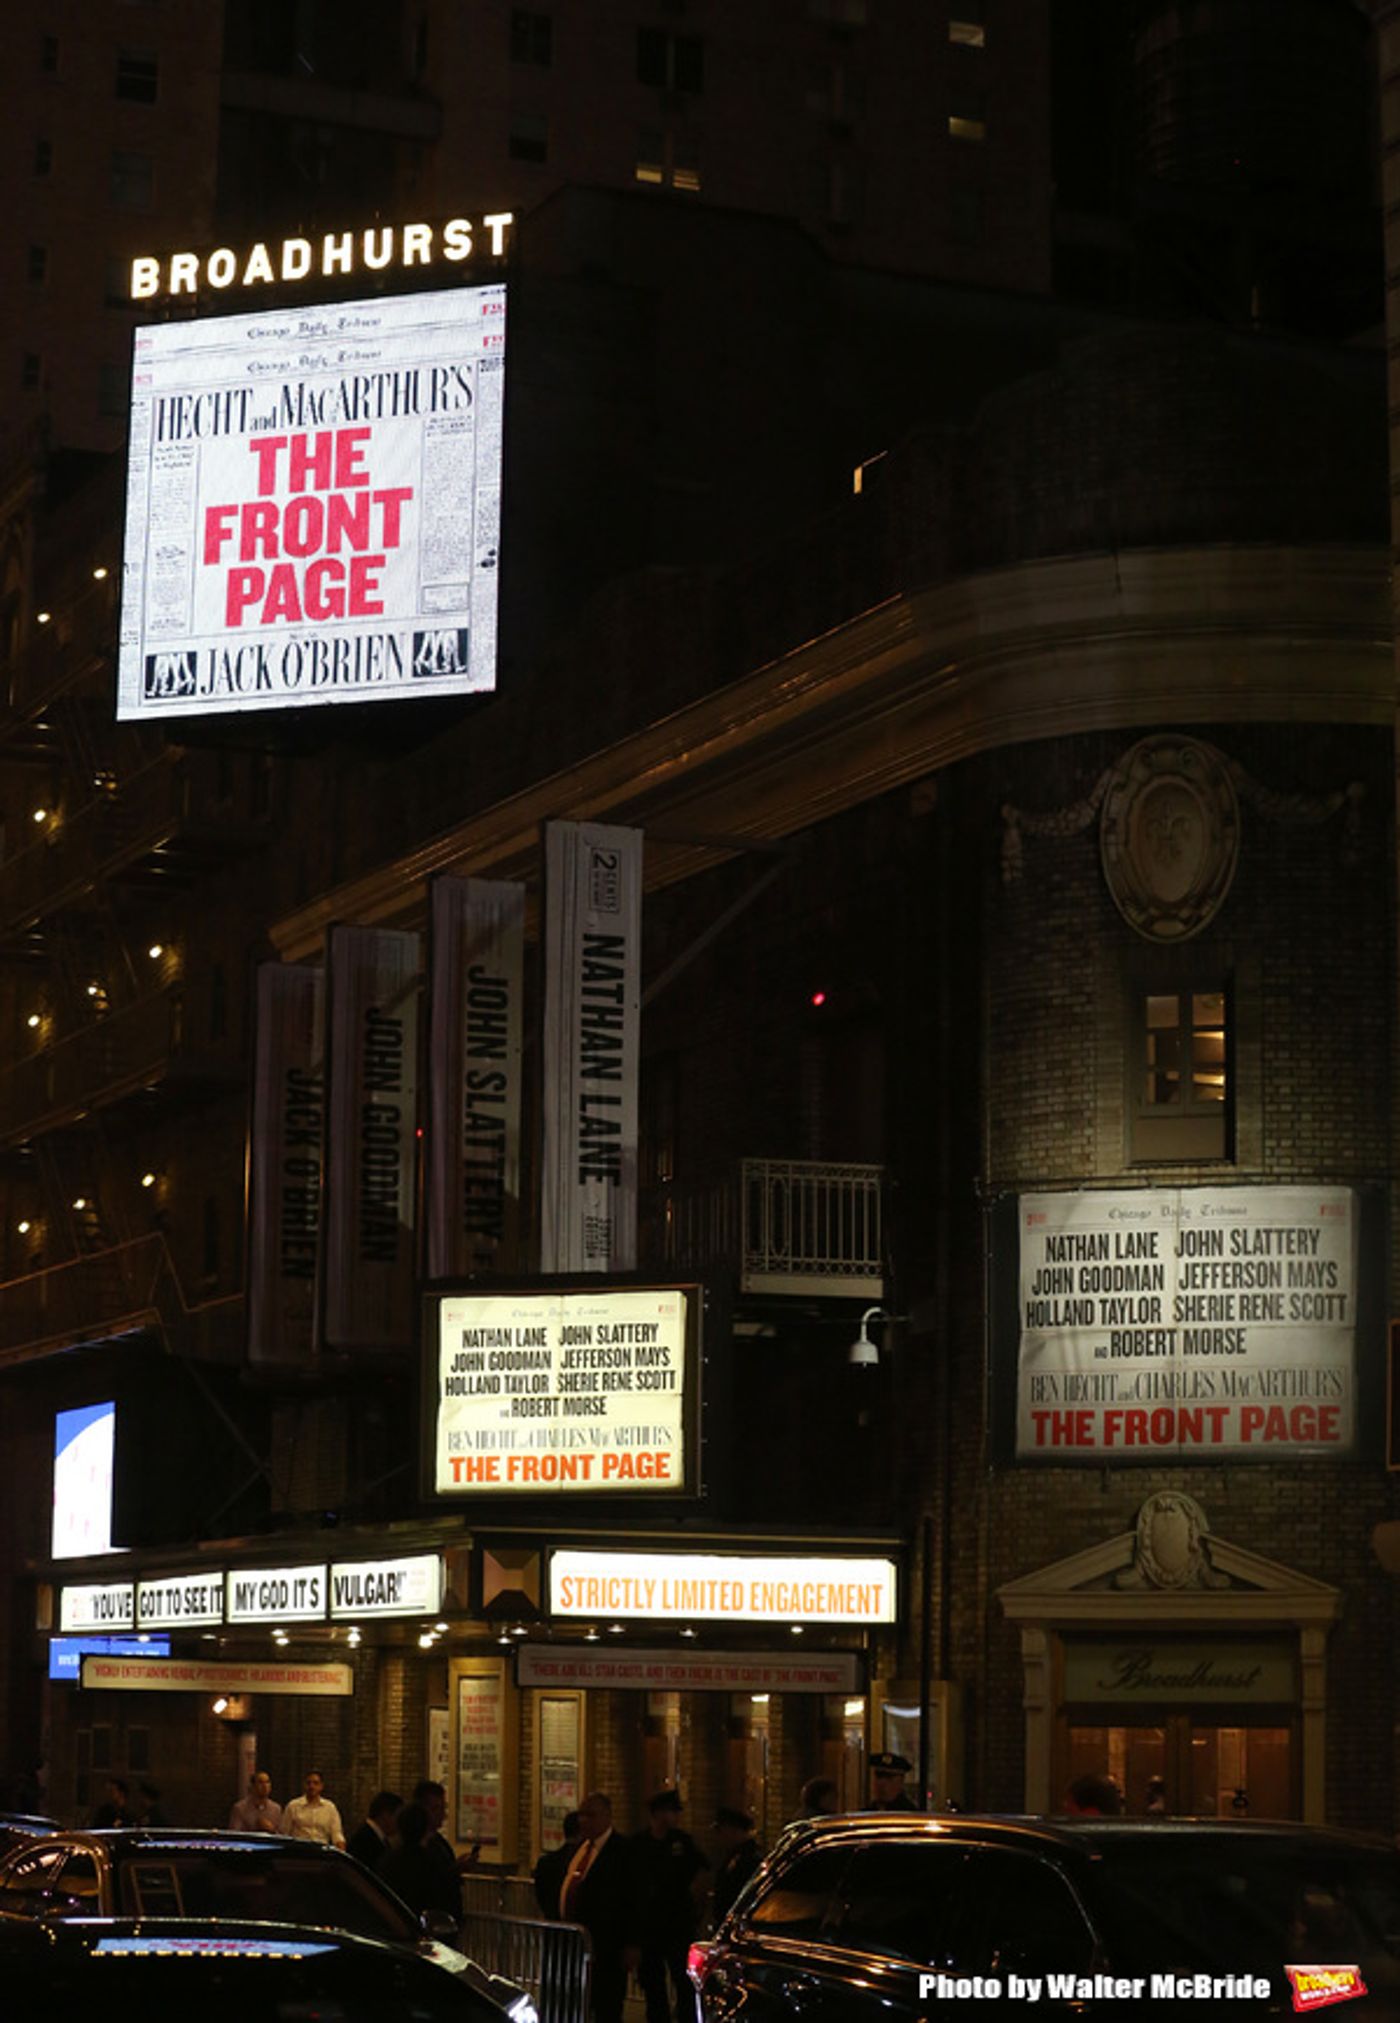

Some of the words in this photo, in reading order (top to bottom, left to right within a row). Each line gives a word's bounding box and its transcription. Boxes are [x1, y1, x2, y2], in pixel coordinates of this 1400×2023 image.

[131, 213, 513, 299] BROADHURST
[158, 388, 253, 442] HECHT
[249, 403, 278, 431] and
[249, 427, 372, 496] THE
[203, 487, 414, 566] FRONT
[225, 554, 386, 627] PAGE
[200, 643, 275, 697] JACK
[281, 633, 405, 689] O'BRIEN
[467, 964, 509, 1060] JOHN
[580, 933, 625, 1082] NATHAN
[364, 1006, 403, 1093] JOHN
[286, 1067, 324, 1148] JACK
[465, 1070, 507, 1241] SLATTERY
[578, 1093, 622, 1188] LANE
[360, 1103, 401, 1263] GOODMAN
[1046, 1233, 1109, 1262] NATHAN
[1115, 1231, 1159, 1260] LANE
[1174, 1229, 1223, 1258] JOHN
[1230, 1228, 1321, 1257] SLATTERY
[1032, 1267, 1074, 1296] JOHN
[1079, 1264, 1164, 1293] GOODMAN
[1179, 1261, 1282, 1290] JEFFERSON
[1288, 1260, 1338, 1288] MAYS
[1026, 1299, 1094, 1328] HOLLAND
[1101, 1296, 1162, 1325] TAYLOR
[1173, 1294, 1235, 1323] SHERIE
[1239, 1293, 1285, 1321] RENE
[1289, 1292, 1347, 1321] SCOTT
[462, 1328, 512, 1348] NATHAN
[516, 1327, 547, 1347] LANE
[558, 1325, 592, 1346] JOHN
[596, 1323, 659, 1345] SLATTERY
[1110, 1329, 1177, 1358] ROBERT
[1183, 1327, 1247, 1355] MORSE
[451, 1352, 484, 1373] JOHN
[488, 1350, 552, 1371] GOODMAN
[560, 1348, 631, 1369] JEFFERSON
[635, 1347, 671, 1367] MAYS
[445, 1376, 500, 1396] HOLLAND
[504, 1374, 549, 1395] TAYLOR
[557, 1372, 599, 1393] SHERIE
[602, 1371, 634, 1392] RENE
[636, 1370, 676, 1390] SCOTT
[1031, 1375, 1060, 1403] BEN
[1064, 1374, 1119, 1402] HECHT
[1135, 1371, 1215, 1400] CHARLES
[511, 1397, 559, 1418] ROBERT
[563, 1396, 607, 1416] MORSE
[1031, 1410, 1095, 1447] THE
[1104, 1407, 1230, 1445] FRONT
[1240, 1406, 1341, 1443] PAGE
[449, 1456, 500, 1482] THE
[507, 1454, 595, 1481] FRONT
[602, 1452, 671, 1479] PAGE
[140, 1589, 163, 1617] GOT
[166, 1588, 182, 1615] TO
[184, 1585, 208, 1614] SEE
[235, 1582, 257, 1611] MY
[560, 1575, 657, 1610] STRICTLY
[662, 1578, 743, 1612] LIMITED
[750, 1581, 883, 1615] ENGAGEMENT
[1097, 1650, 1261, 1690] Broadhurst
